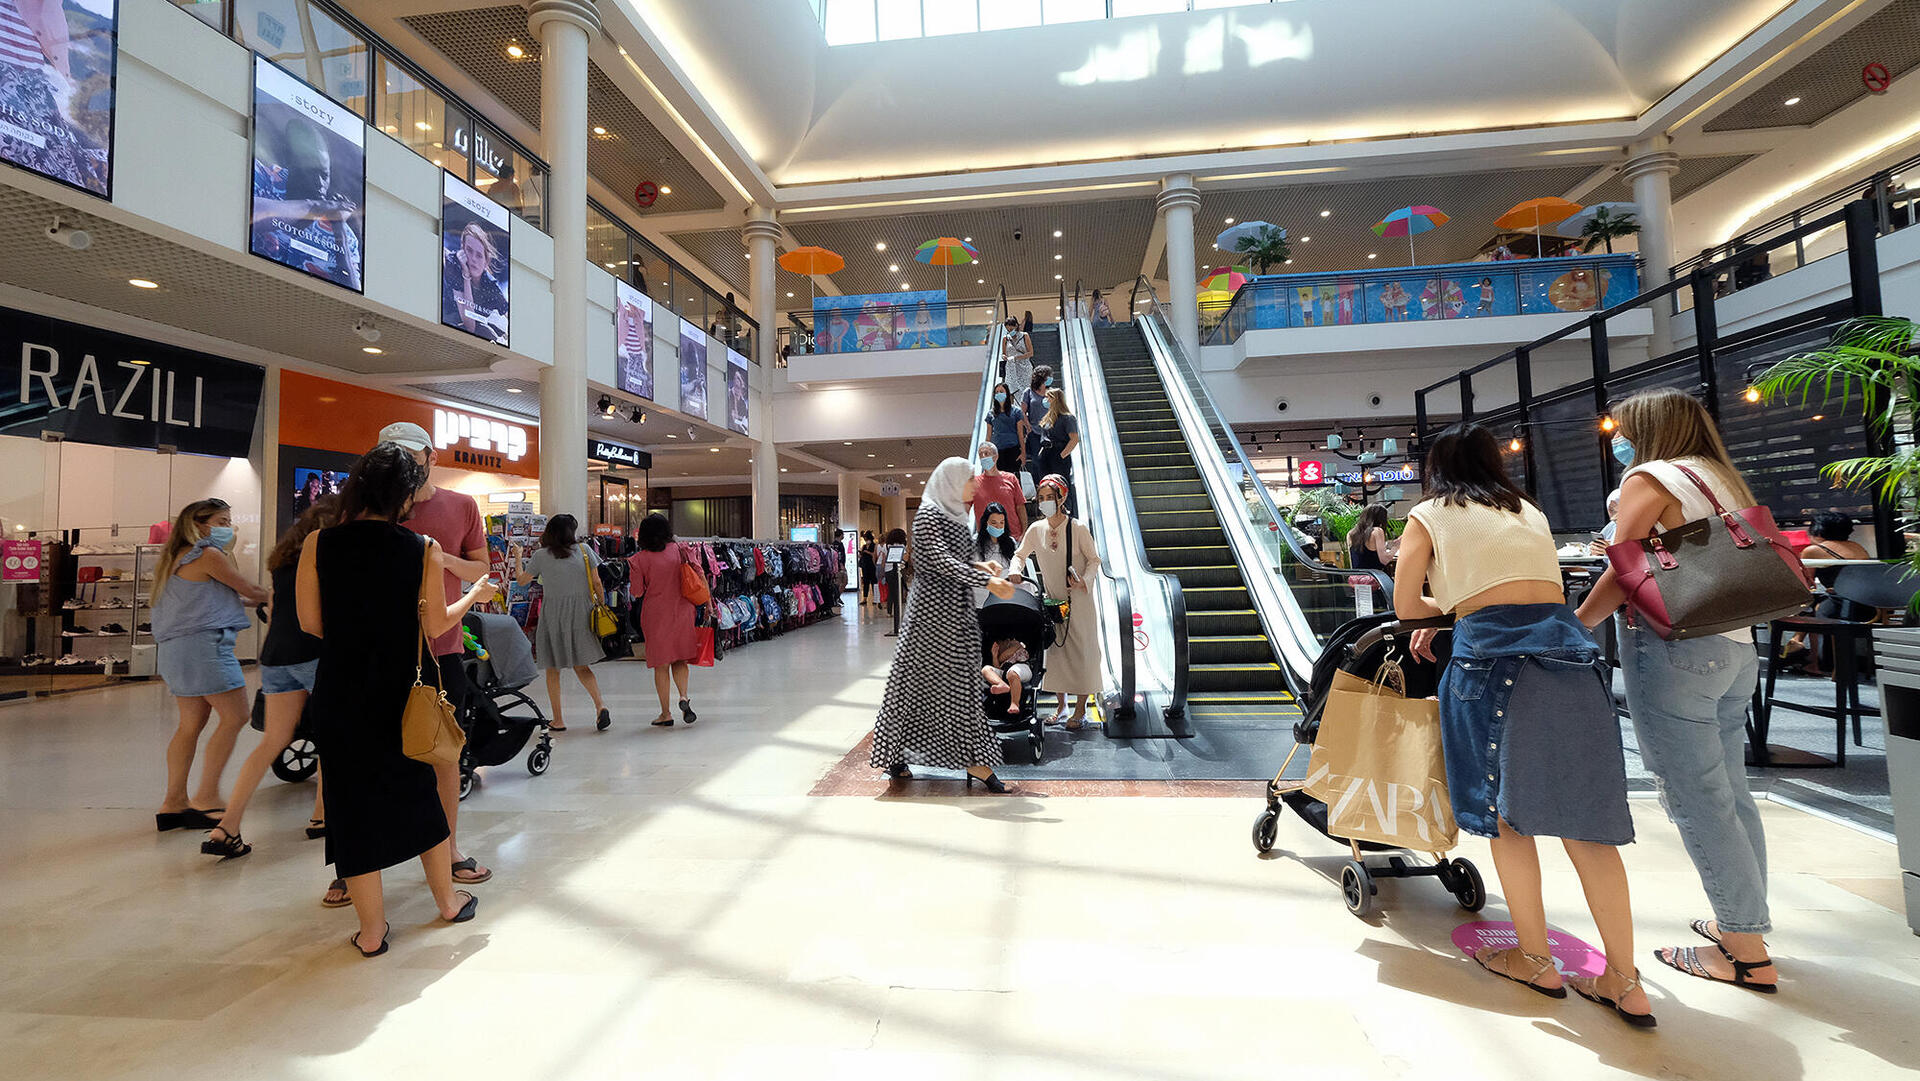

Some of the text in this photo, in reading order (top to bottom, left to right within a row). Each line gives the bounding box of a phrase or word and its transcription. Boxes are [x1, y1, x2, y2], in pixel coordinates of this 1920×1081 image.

[20, 342, 203, 428] RAZILI
[434, 409, 527, 461] קרביץ
[455, 450, 501, 468] KRAVITZ
[1327, 774, 1447, 843] ZARA
